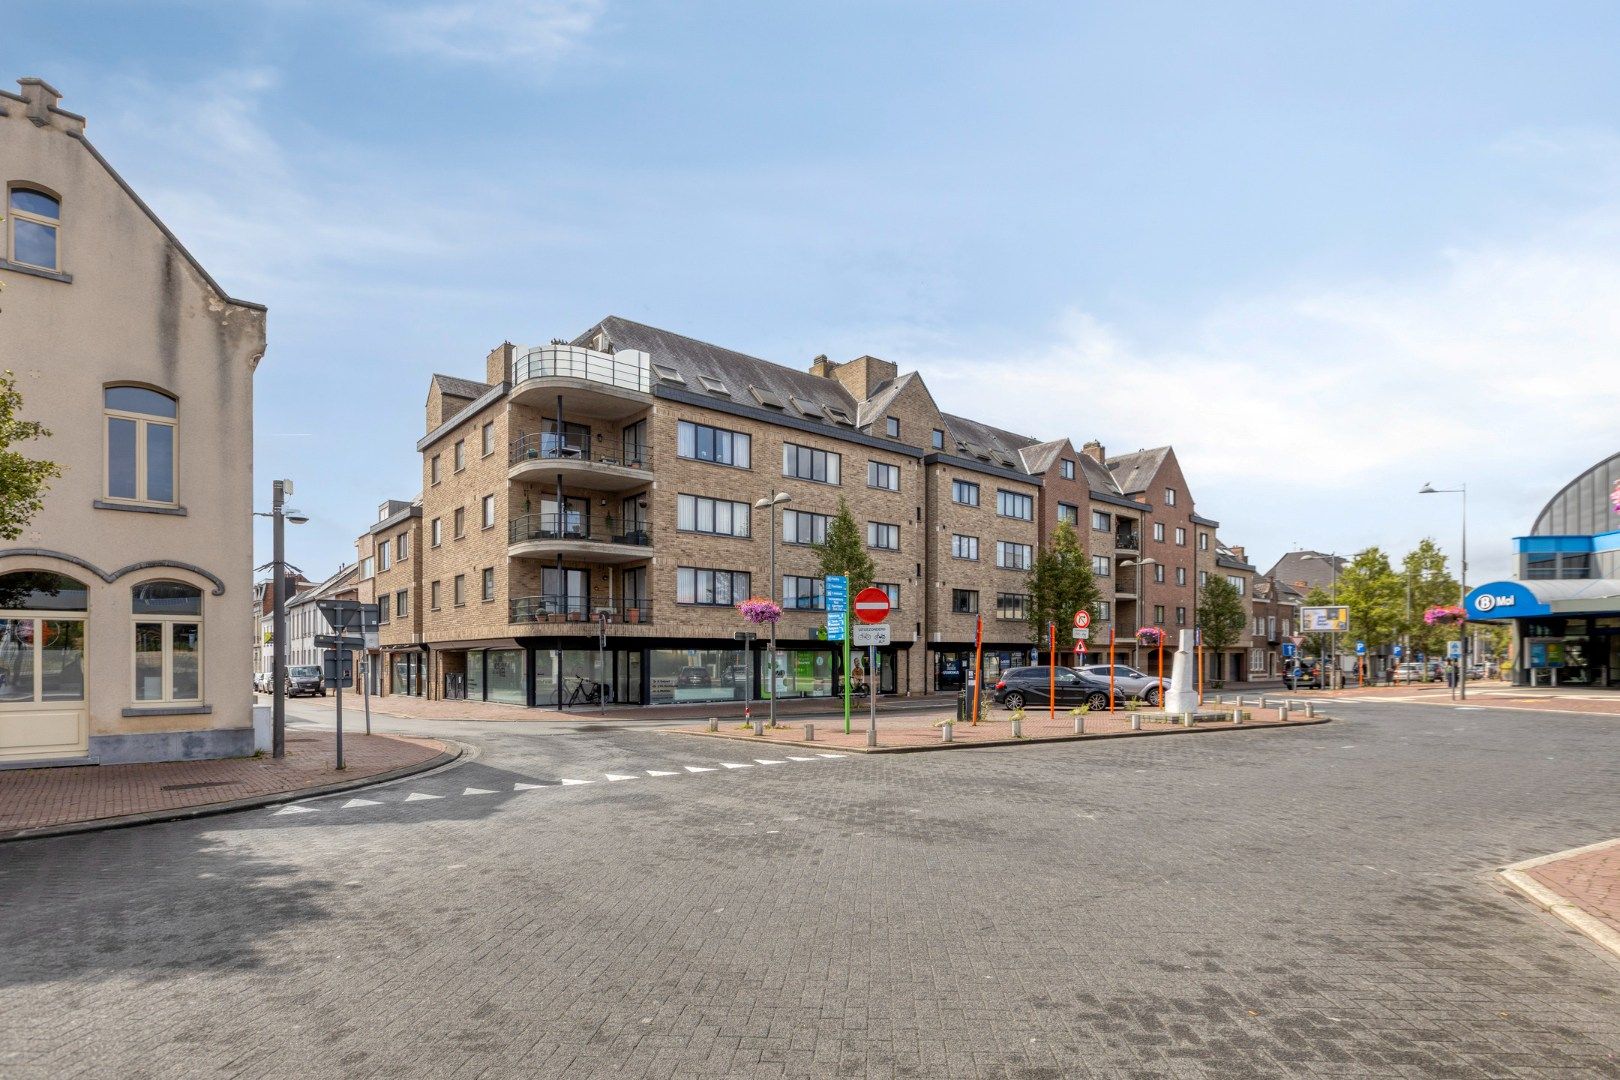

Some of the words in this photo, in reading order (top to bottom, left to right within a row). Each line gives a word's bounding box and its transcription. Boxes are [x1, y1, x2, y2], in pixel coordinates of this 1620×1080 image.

[1496, 594, 1514, 606] Mol
[1357, 642, 1364, 651] P
[1394, 646, 1400, 656] P
